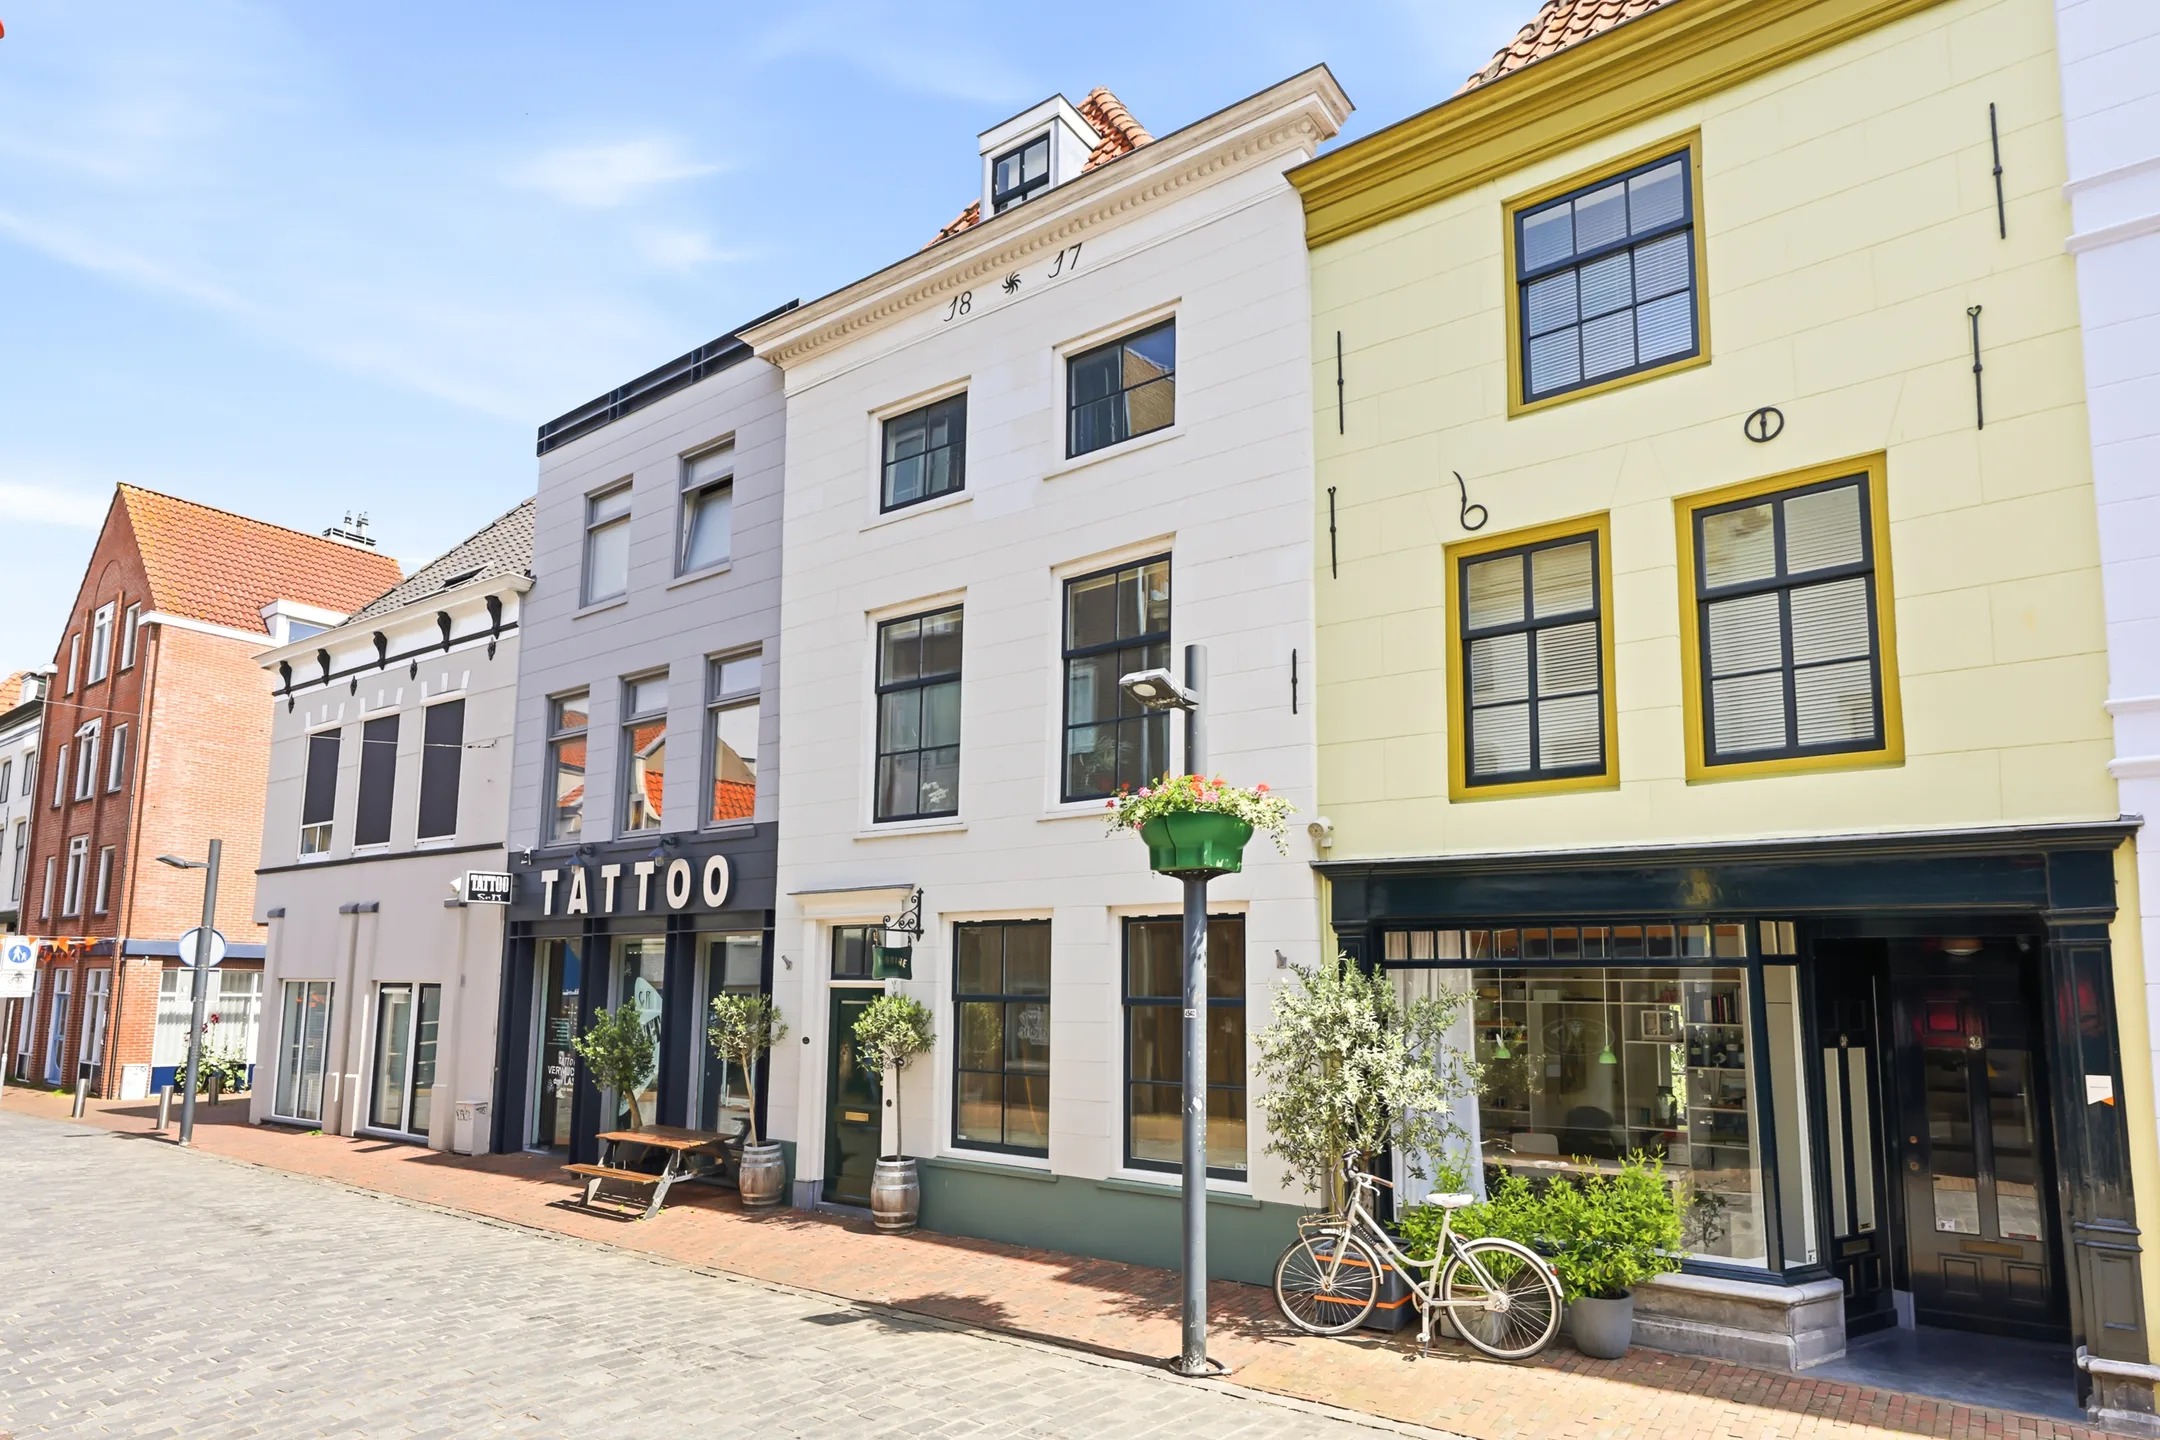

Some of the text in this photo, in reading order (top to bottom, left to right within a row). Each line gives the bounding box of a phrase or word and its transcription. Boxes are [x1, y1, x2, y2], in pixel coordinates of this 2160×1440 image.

[470, 874, 510, 893] TATTOO
[541, 854, 729, 916] TATTOO
[1969, 1036, 1982, 1049] 34
